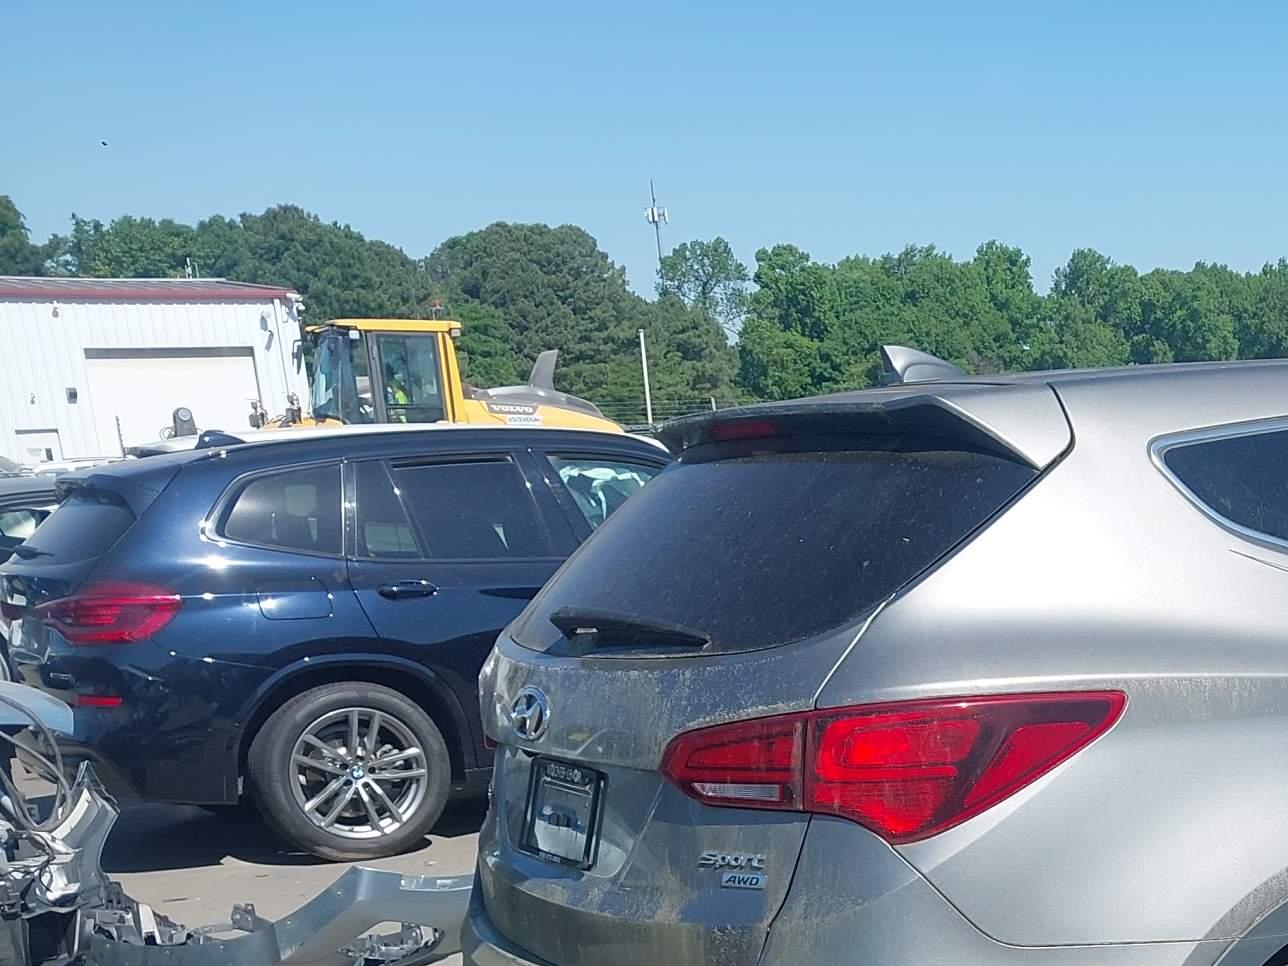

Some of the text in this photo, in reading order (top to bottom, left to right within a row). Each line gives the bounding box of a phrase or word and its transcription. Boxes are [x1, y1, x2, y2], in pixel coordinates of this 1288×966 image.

[490, 405, 534, 413] VOLVO
[697, 851, 766, 872] Sport
[724, 875, 761, 886] AWD
